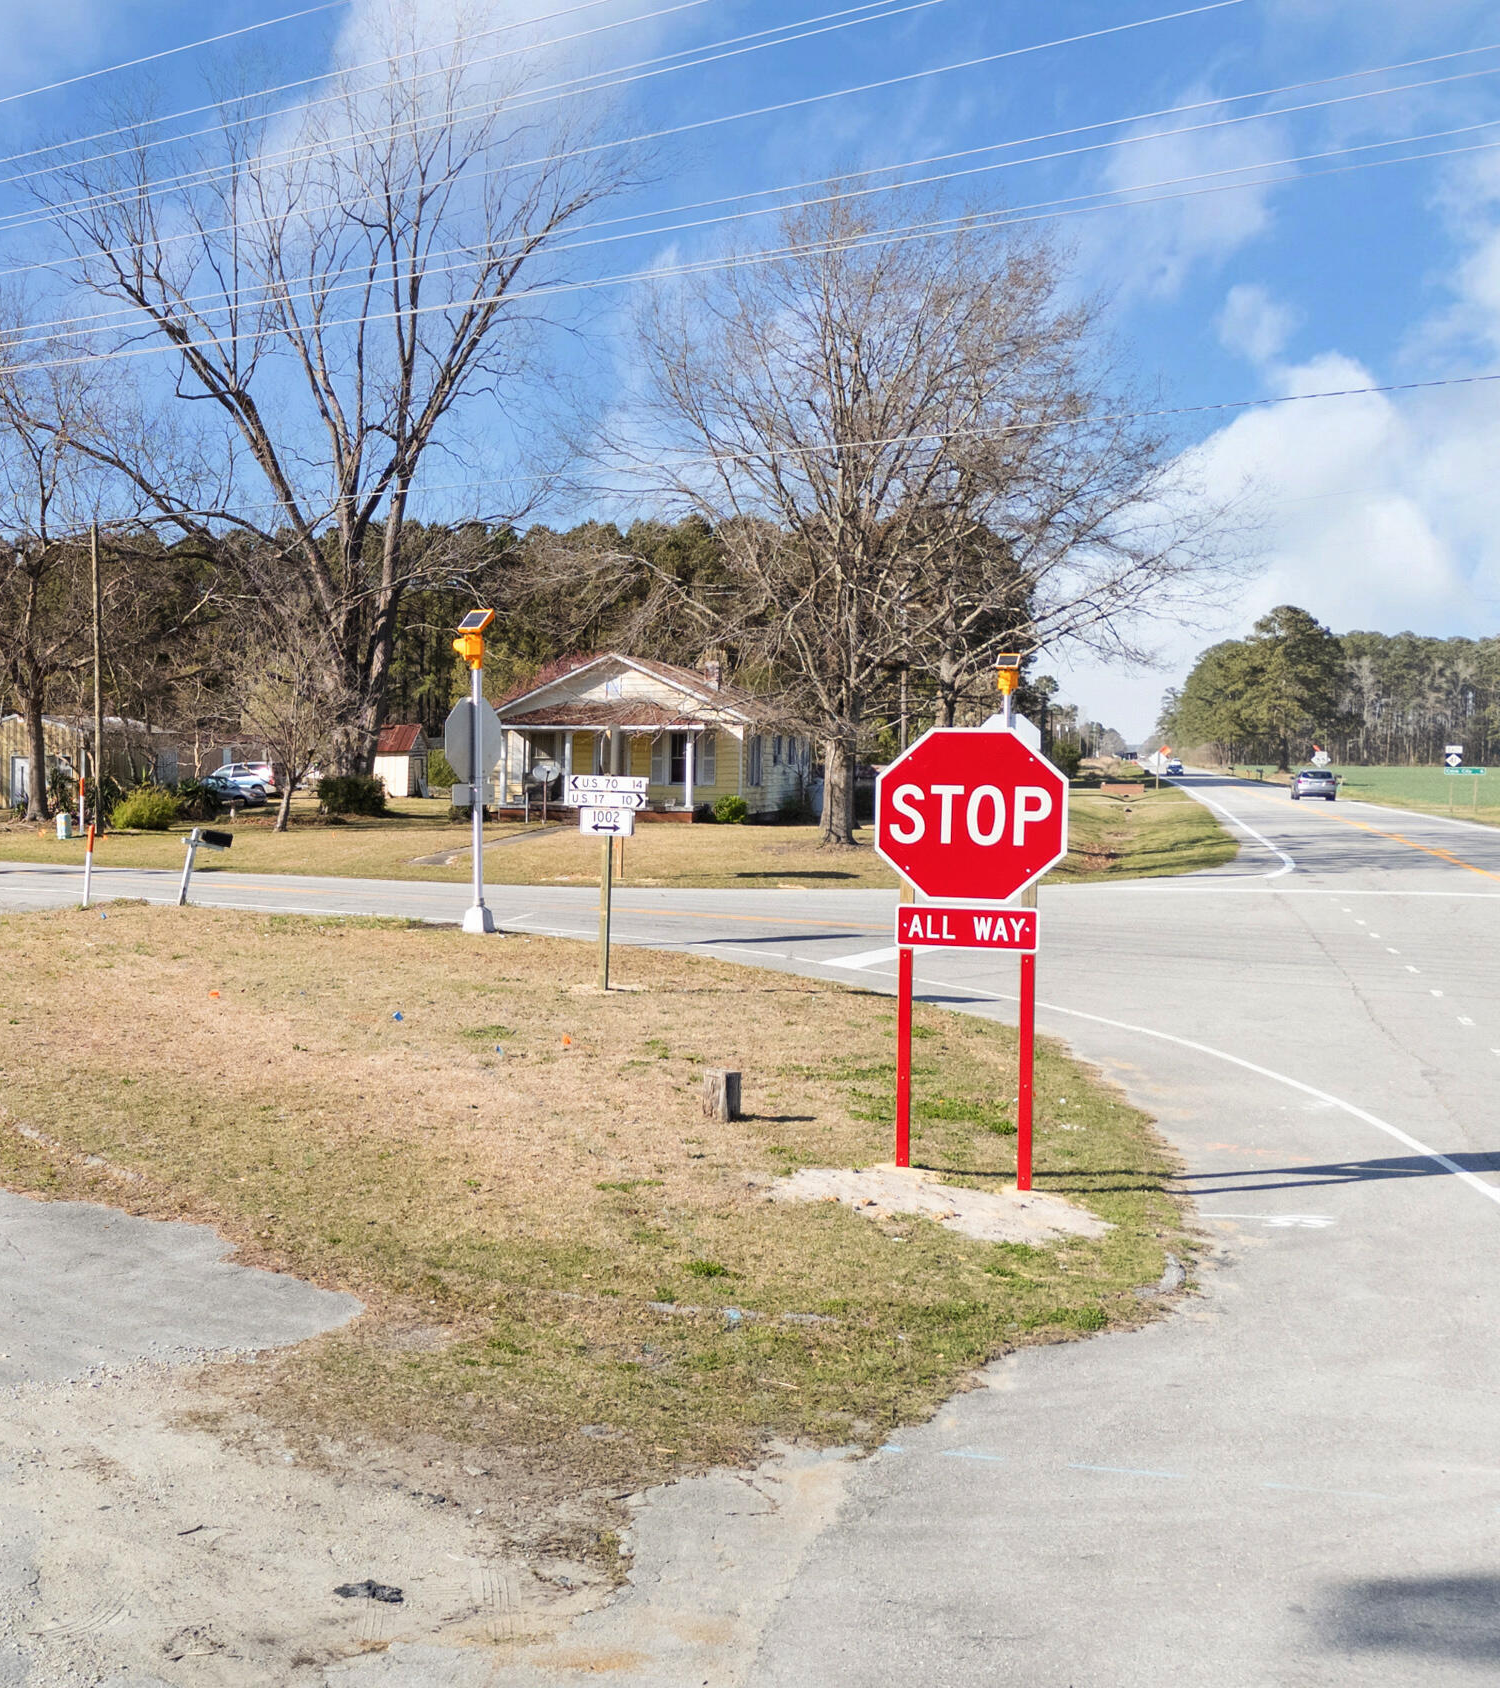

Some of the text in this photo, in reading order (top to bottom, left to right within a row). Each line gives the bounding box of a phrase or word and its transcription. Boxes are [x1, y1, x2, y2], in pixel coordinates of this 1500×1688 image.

[605, 779, 618, 789] 70
[632, 780, 642, 789] 14
[594, 794, 605, 803] 17
[622, 796, 633, 805] 10
[593, 811, 620, 823] 1002
[889, 783, 1052, 847] STOP
[908, 914, 1026, 942] ALL WAY
